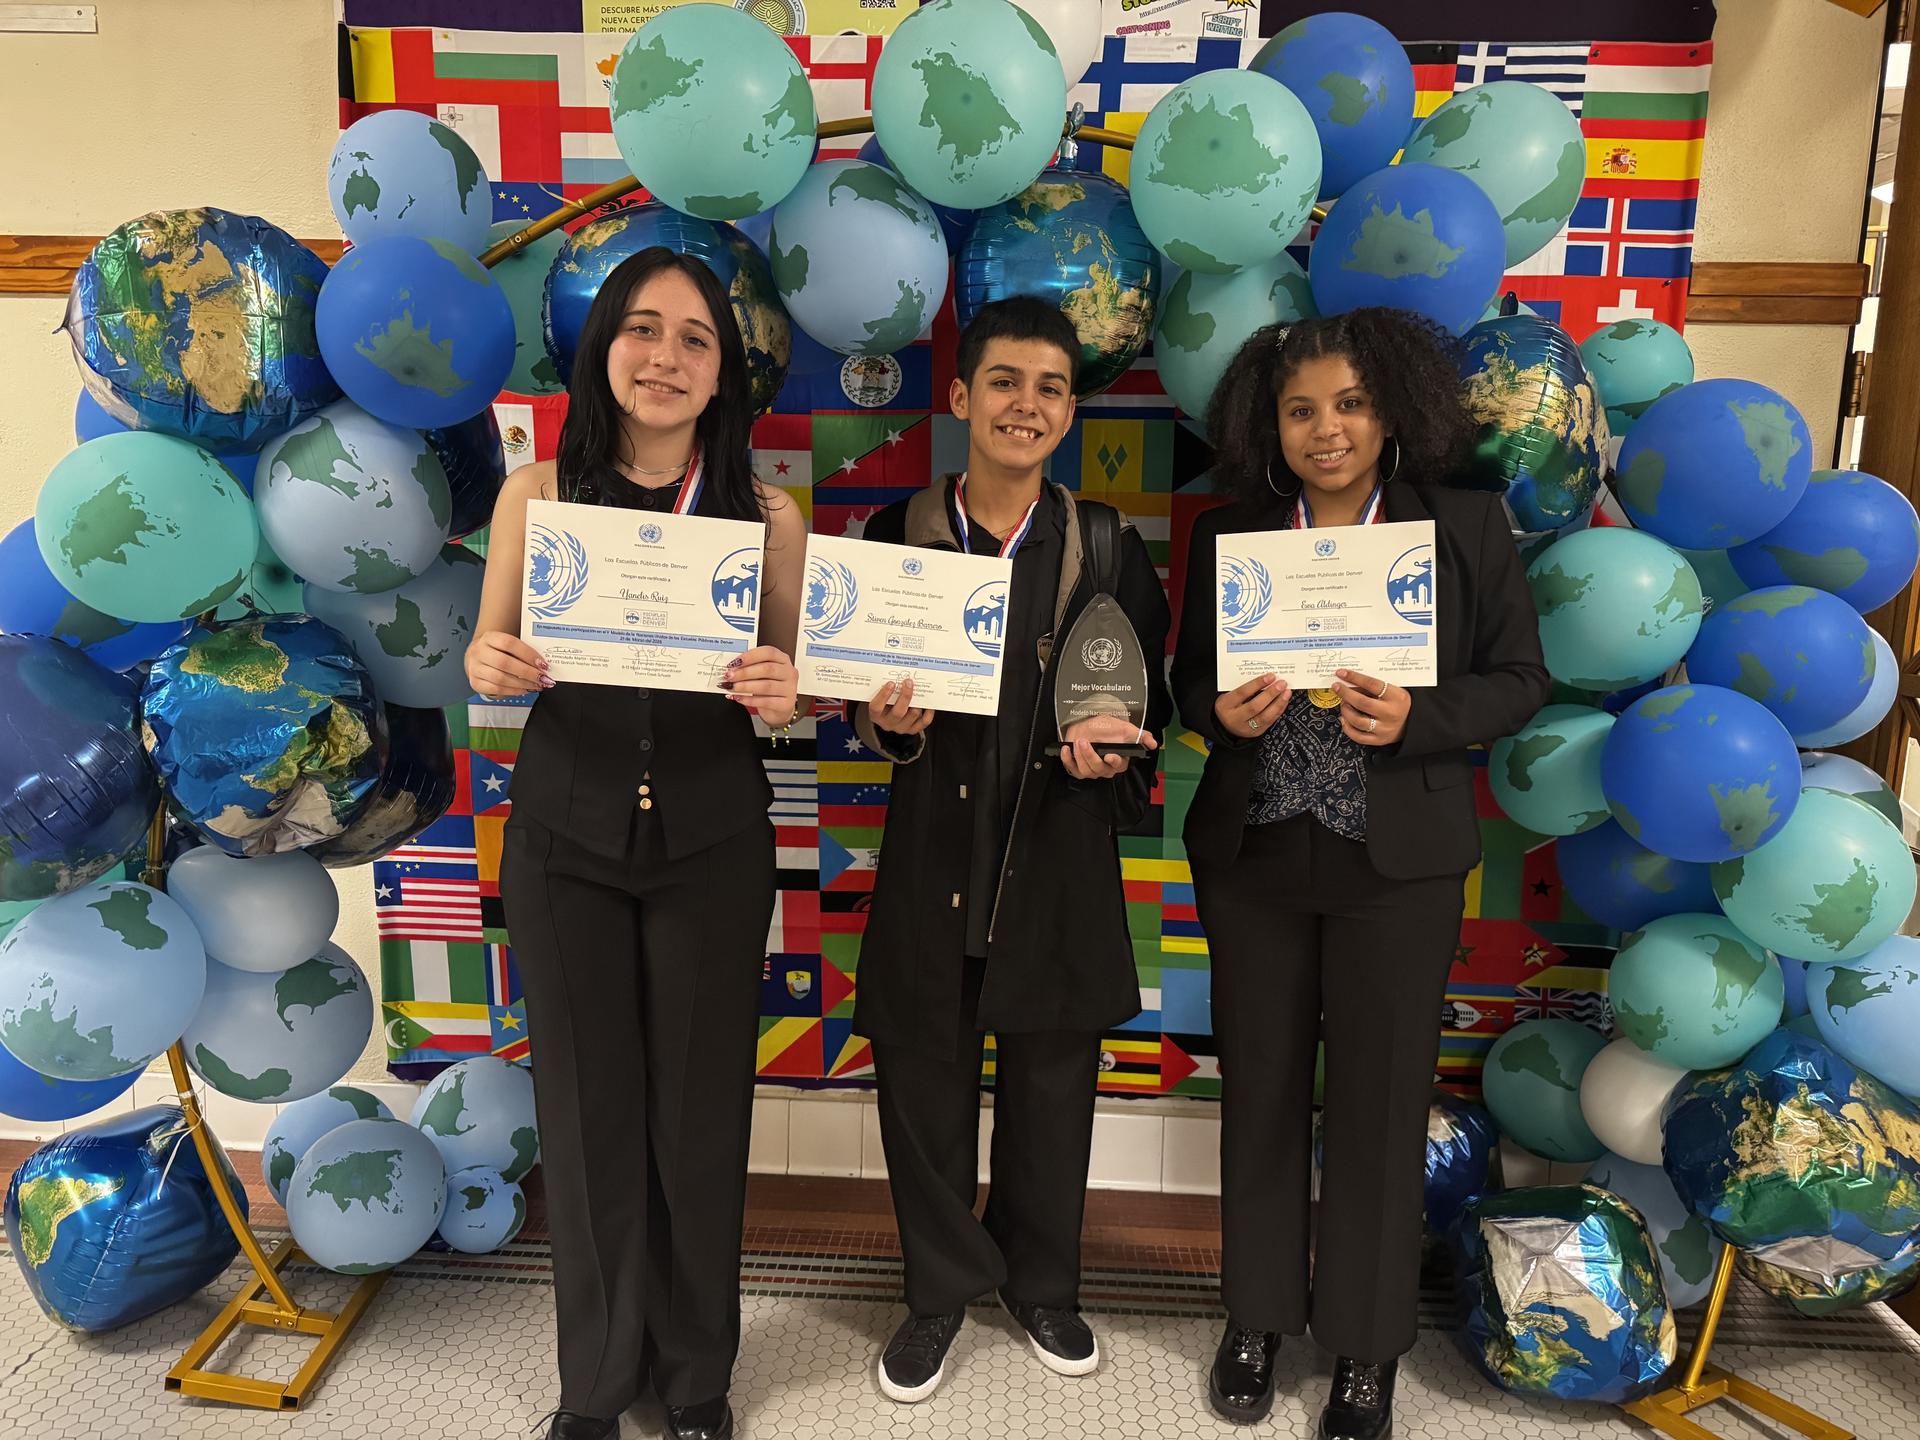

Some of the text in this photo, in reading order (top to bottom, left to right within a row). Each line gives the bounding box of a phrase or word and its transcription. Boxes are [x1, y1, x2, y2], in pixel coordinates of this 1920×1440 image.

[601, 6, 640, 14] DESCUBRE
[642, 5, 659, 13] MÁS
[1211, 14, 1242, 27] SCRIPT
[1116, 20, 1171, 35] CARTOONING
[1206, 22, 1243, 36] WRITING
[615, 557, 638, 565] Escuelas
[650, 591, 669, 604] Ruiz
[1071, 683, 1132, 692] Mejor Vocabulario
